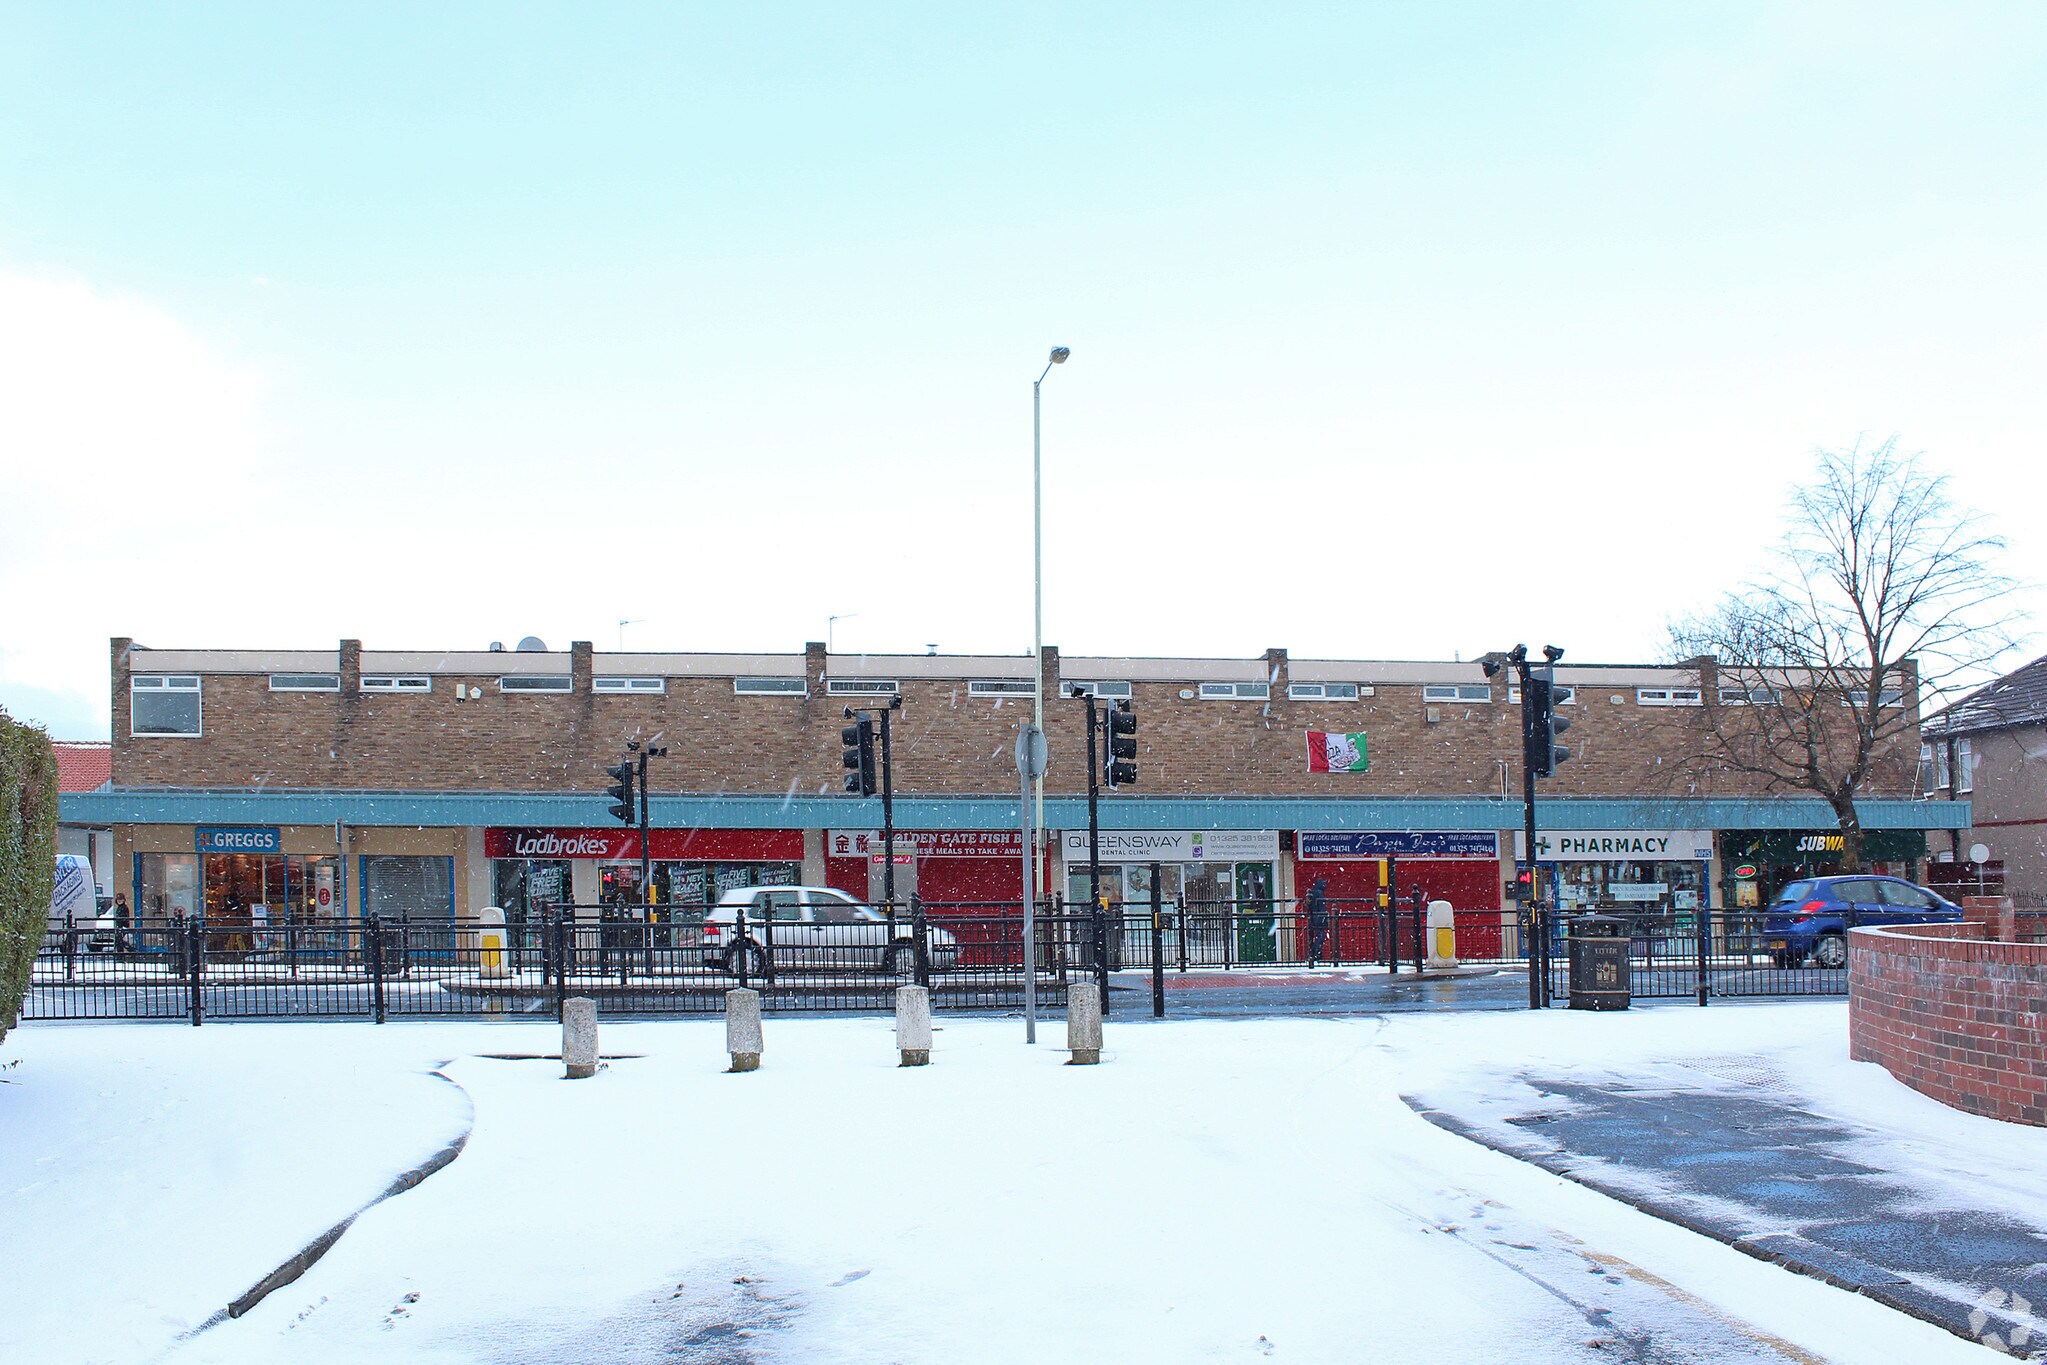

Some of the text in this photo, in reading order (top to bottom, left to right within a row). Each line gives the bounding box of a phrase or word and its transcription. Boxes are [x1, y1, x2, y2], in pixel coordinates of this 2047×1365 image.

[215, 833, 274, 848] GREGGS
[515, 834, 609, 855] Ladbrokes
[941, 833, 977, 843] GATE
[980, 833, 1011, 844] FISH
[1355, 834, 1404, 850] Papa
[1560, 838, 1669, 853] PHARMACY
[1795, 835, 1844, 852] SUBWA
[936, 847, 963, 855] MEALS
[1694, 850, 1711, 858] NHS
[54, 856, 78, 885] AYLOR
[728, 868, 747, 878] FIVE
[1736, 867, 1755, 876] OPEN
